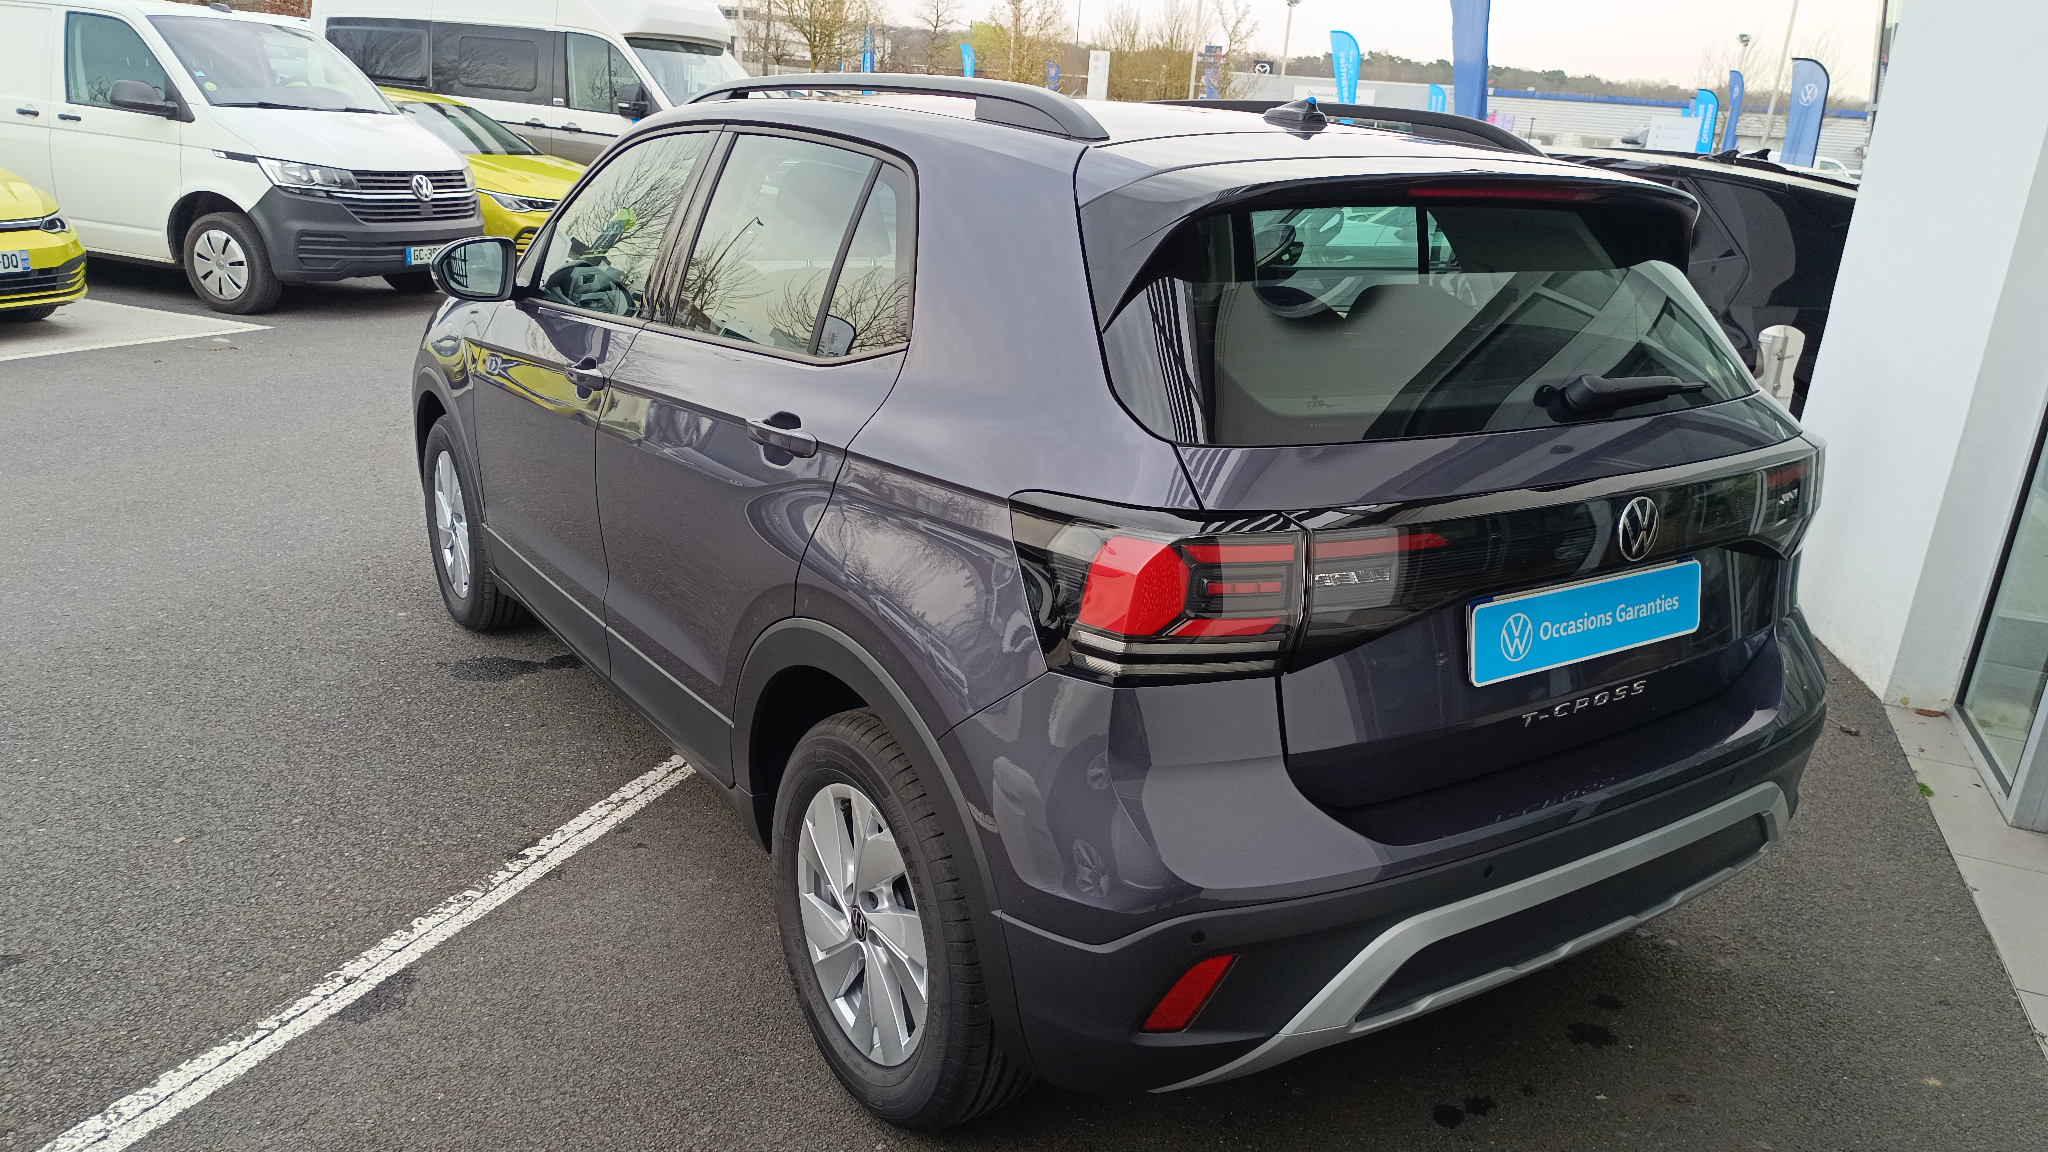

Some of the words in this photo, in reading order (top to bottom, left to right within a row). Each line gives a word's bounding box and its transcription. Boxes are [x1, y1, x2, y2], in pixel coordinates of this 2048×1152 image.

[1540, 612, 1613, 641] Occasions
[1616, 594, 1679, 622] Garanties
[1522, 680, 1647, 727] T-CROSS
